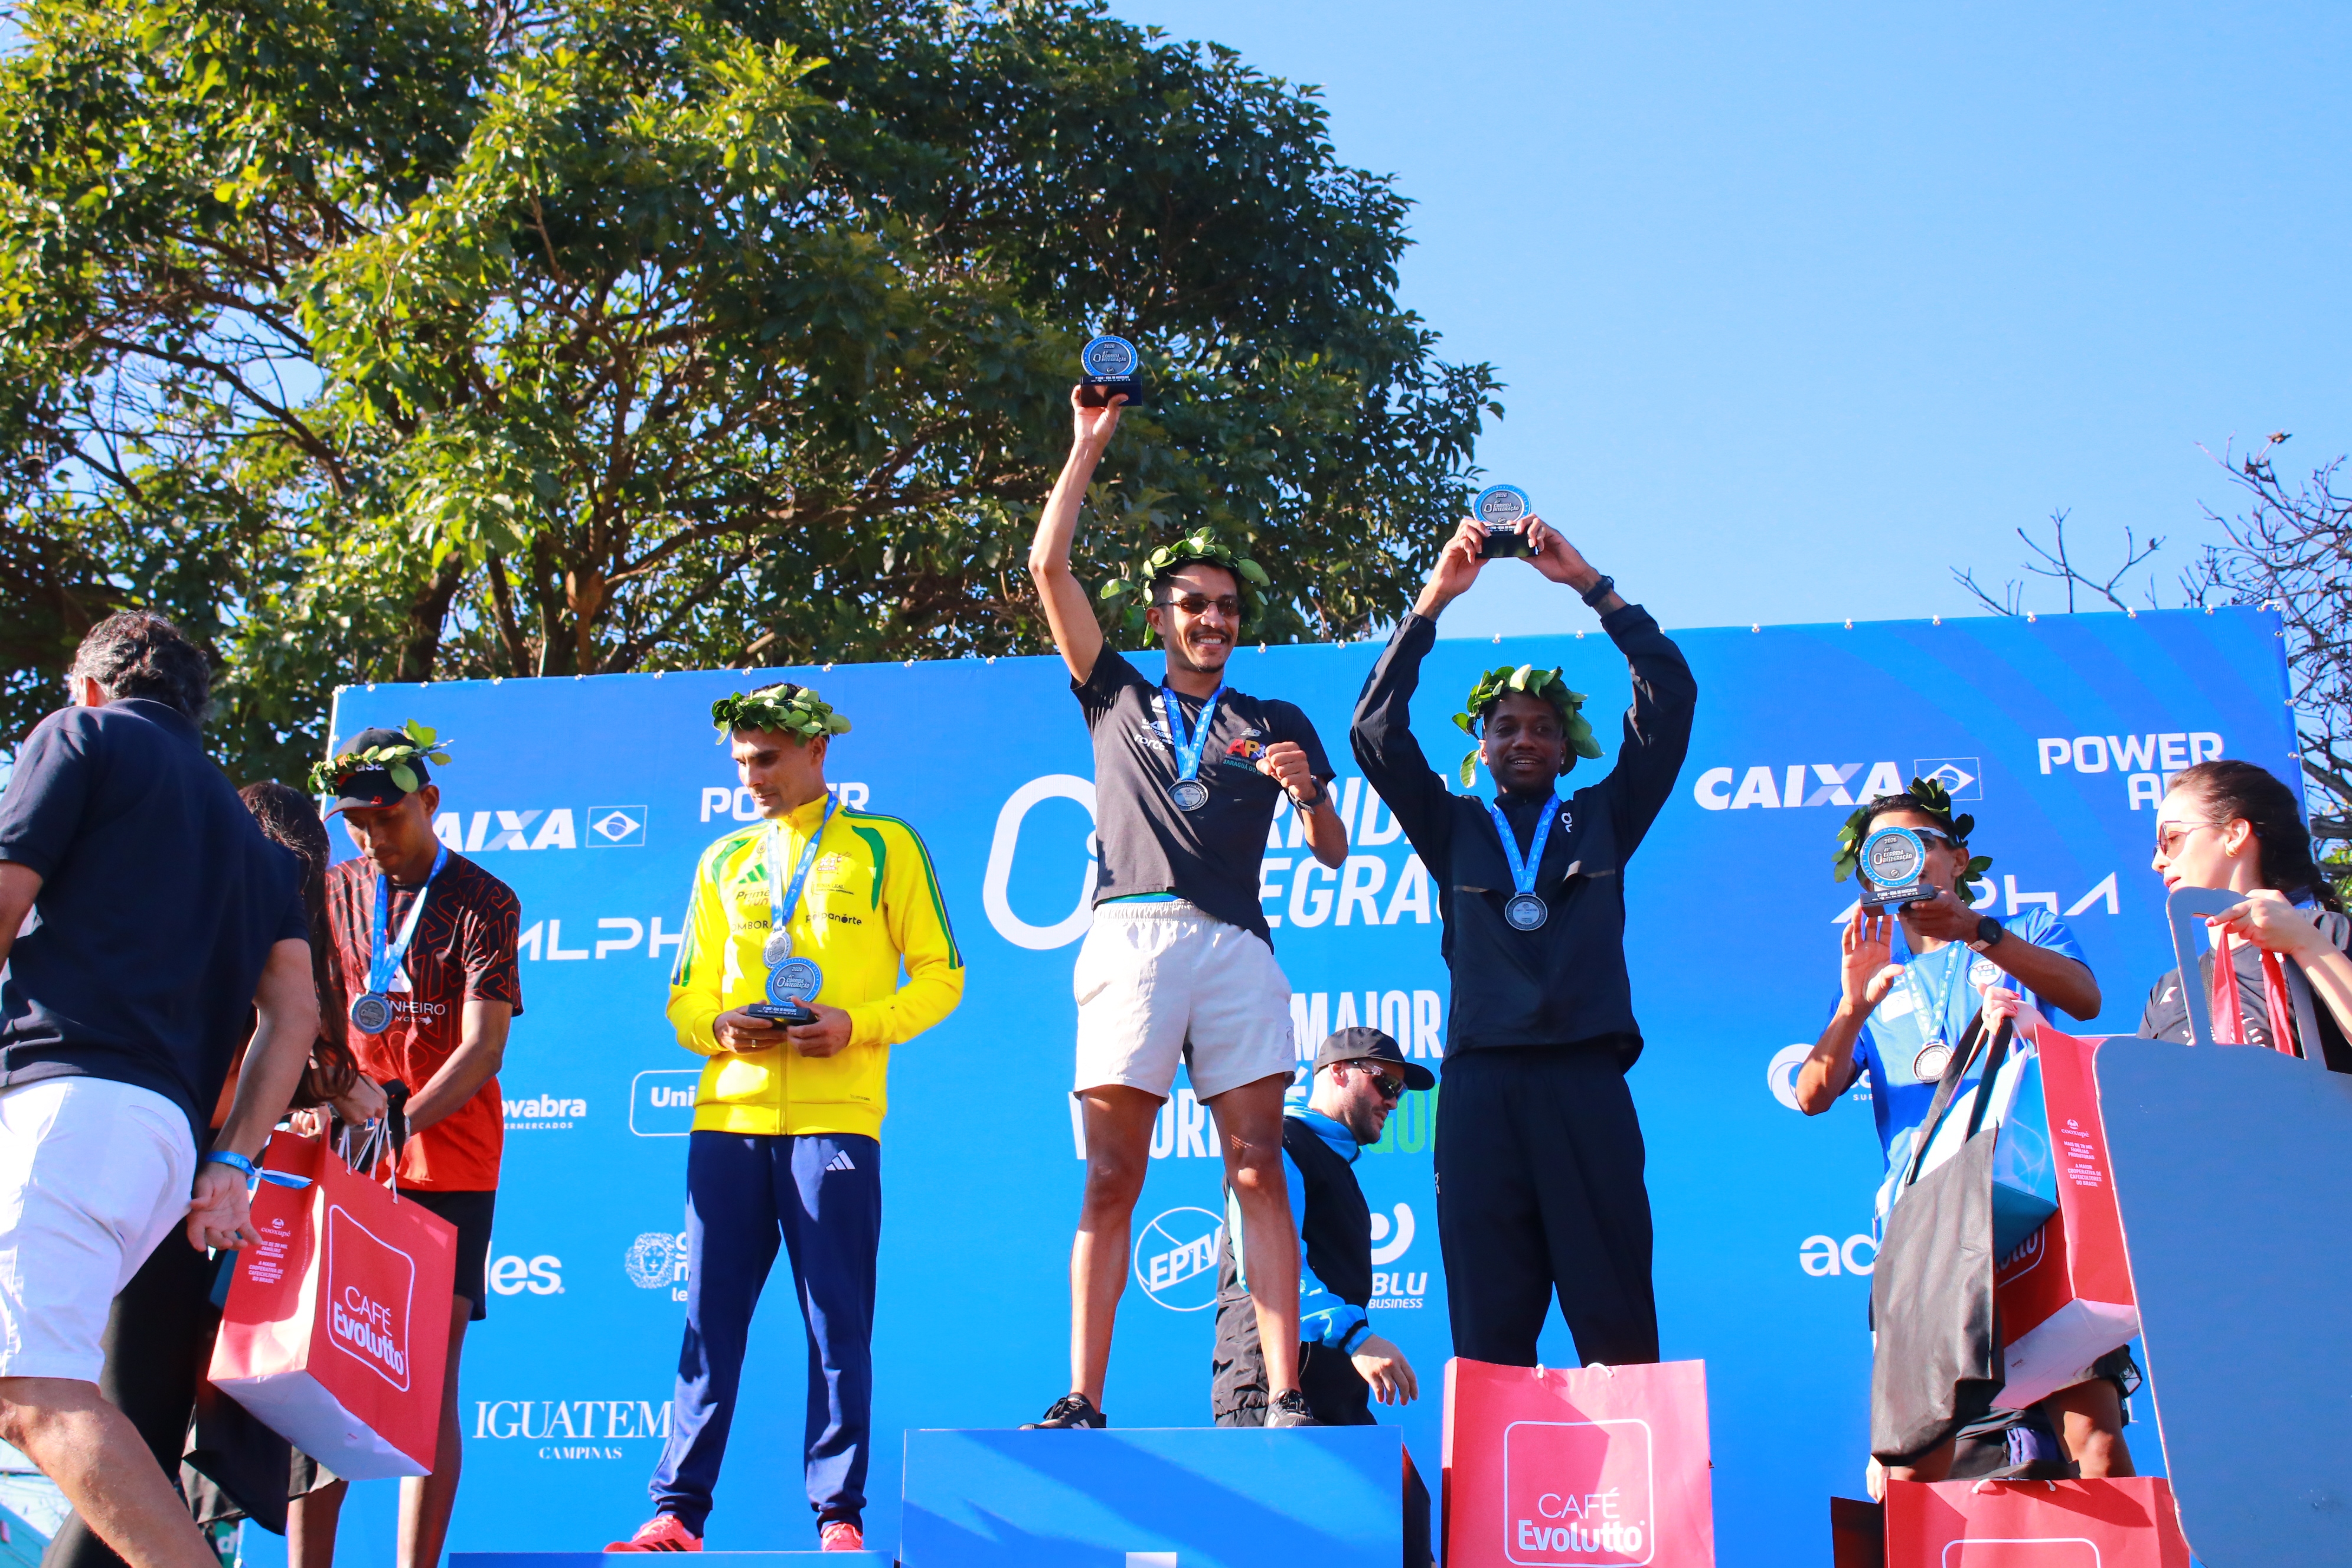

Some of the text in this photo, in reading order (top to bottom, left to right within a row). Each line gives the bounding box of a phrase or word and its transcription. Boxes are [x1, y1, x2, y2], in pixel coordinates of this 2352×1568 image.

[2038, 732, 2224, 775] POWER
[700, 782, 870, 822] POR
[1694, 761, 1906, 811] CAIXA
[432, 808, 577, 852] AIXA
[518, 917, 684, 961] ALPH
[2061, 1128, 2090, 1138] cooxupé
[2067, 1168, 2096, 1176] COOPERATIVA
[2069, 1174, 2102, 1182] CAFEICULTORES
[261, 1227, 291, 1237] cooxupé
[1150, 1224, 1224, 1292] EPTV
[345, 1286, 393, 1337] CAFÉ
[1368, 1298, 1423, 1309] BUSINESS
[334, 1301, 404, 1376] Evolutto
[472, 1400, 674, 1439] IGUATEM
[538, 1446, 623, 1459] CAMPINAS
[1538, 1487, 1620, 1519] CAFÉ
[1518, 1519, 1642, 1553] Evolutto
